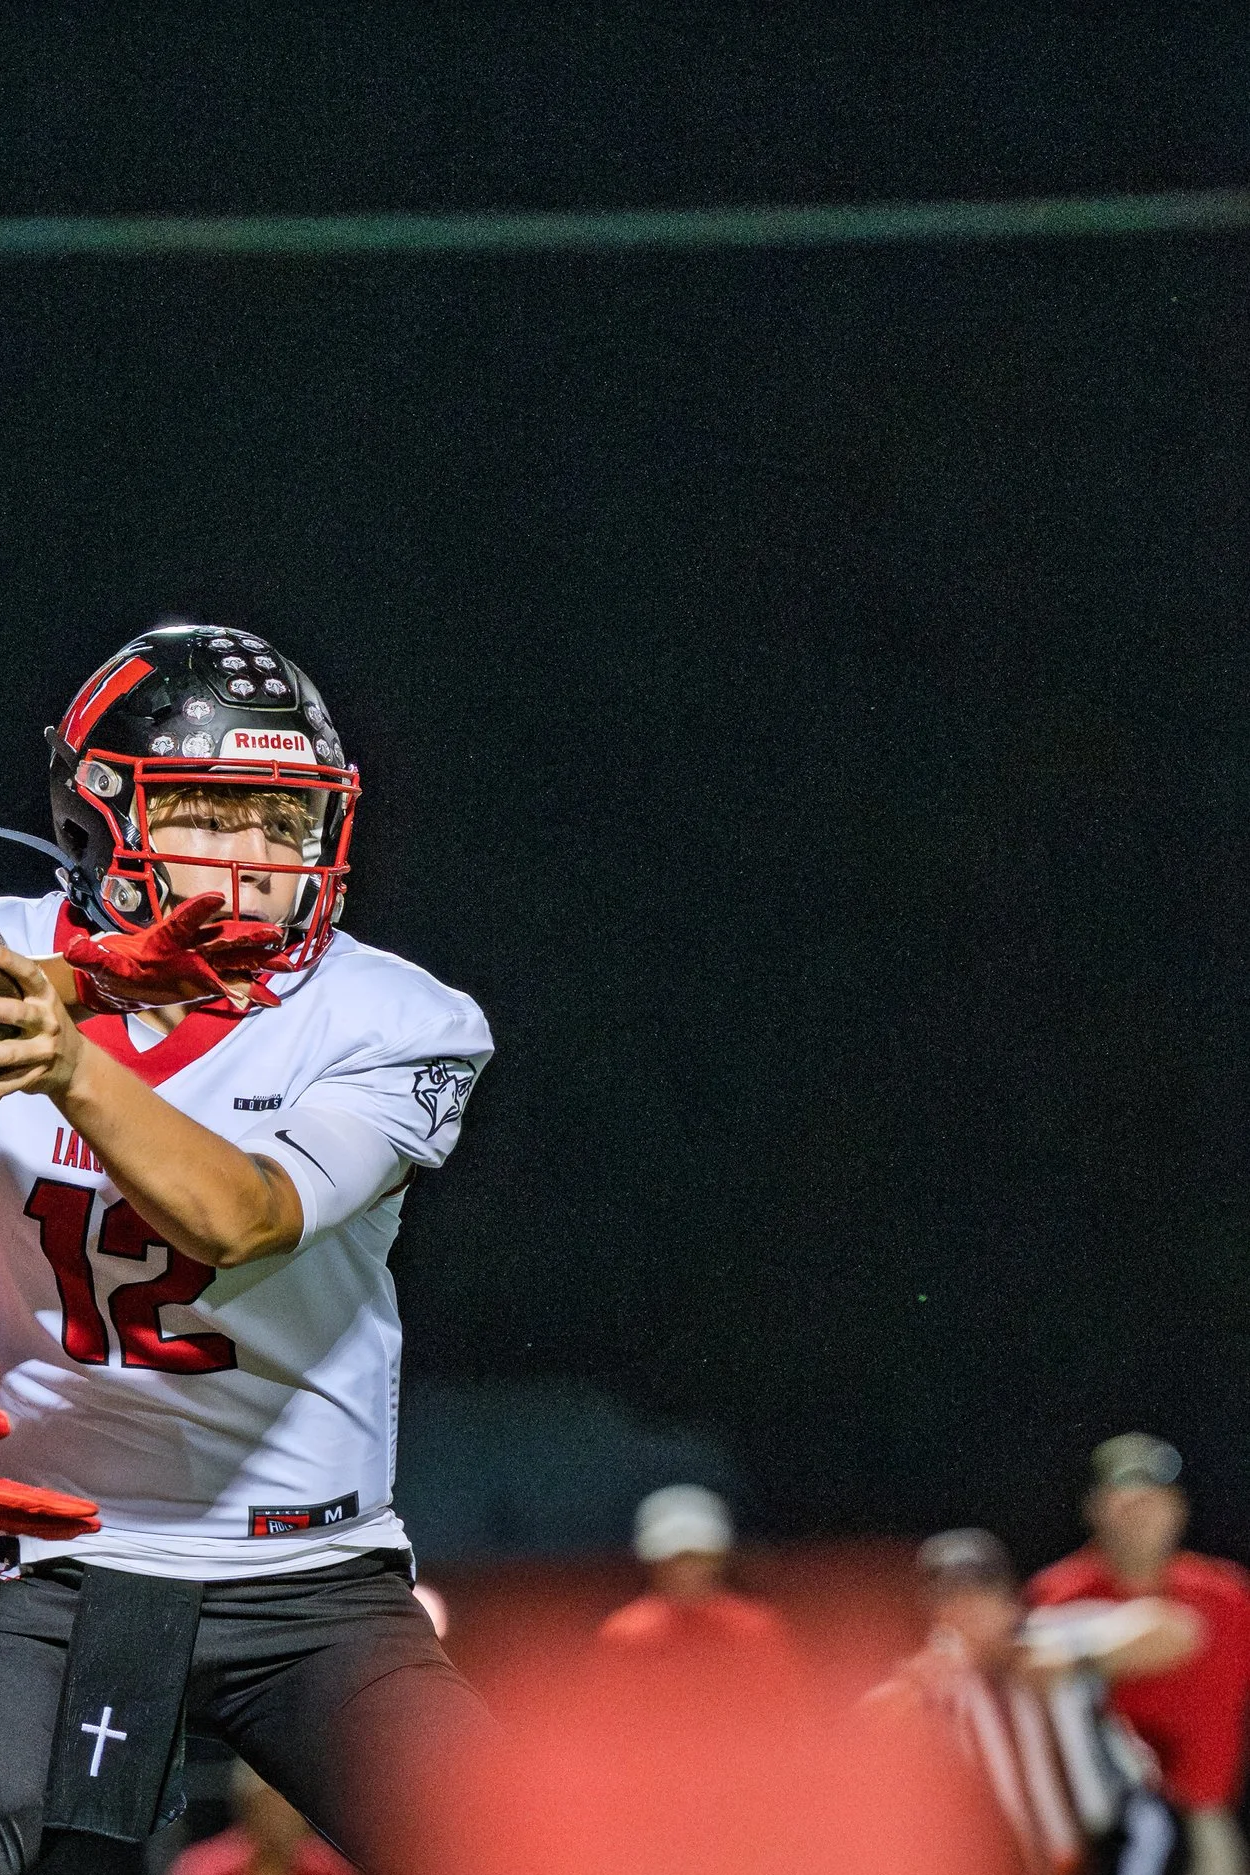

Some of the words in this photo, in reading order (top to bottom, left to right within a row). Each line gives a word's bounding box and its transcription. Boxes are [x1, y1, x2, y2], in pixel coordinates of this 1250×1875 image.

[234, 732, 306, 752] Riddell
[23, 1176, 238, 1376] 12
[324, 1505, 344, 1524] M
